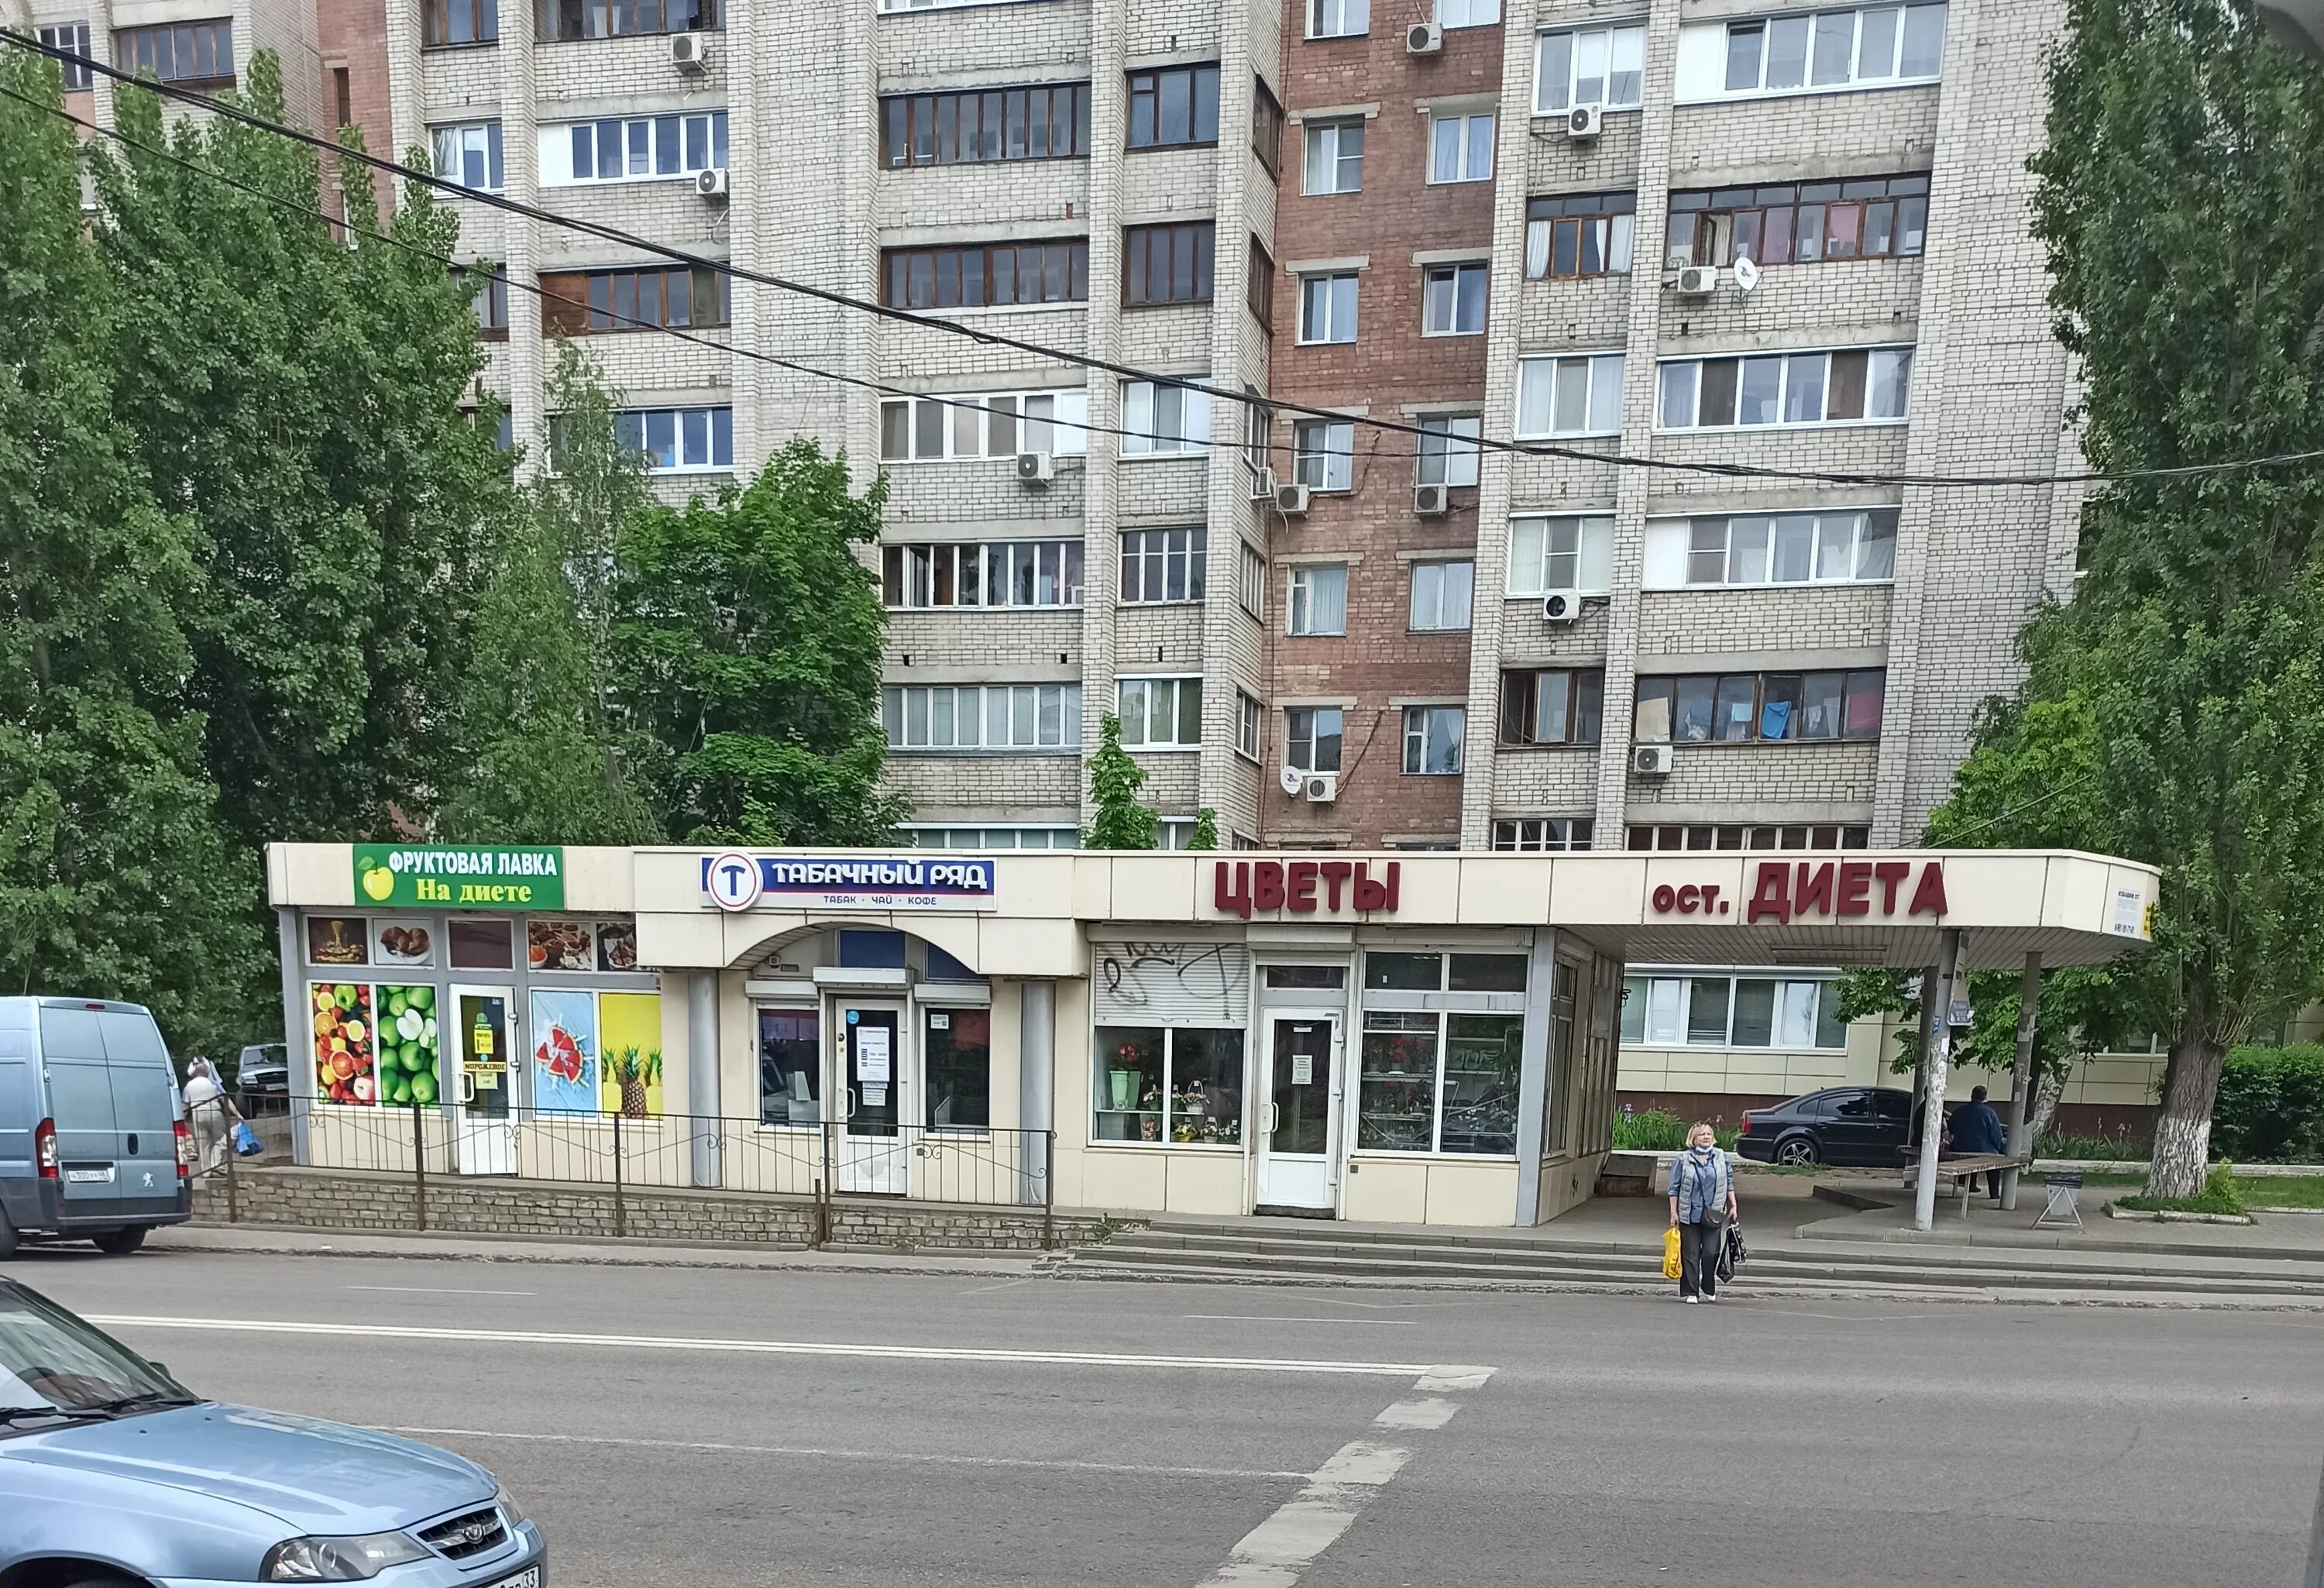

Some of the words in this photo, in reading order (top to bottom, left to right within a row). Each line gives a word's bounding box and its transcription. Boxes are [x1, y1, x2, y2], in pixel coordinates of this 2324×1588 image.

[389, 851, 494, 875] ФРУКТОВАЯ
[497, 853, 558, 876] ЛАВКА
[772, 860, 924, 885] ТАБАЧНЫЙ
[930, 864, 988, 890] РЯД
[416, 878, 452, 901] На
[459, 884, 532, 904] диете
[823, 895, 857, 905] ТАБАК
[871, 894, 892, 905] ЧАЙ
[908, 896, 937, 906] КОФЕ
[1215, 861, 1401, 919] ЦВЕТЫ
[1748, 862, 1948, 924] ДИЕТА
